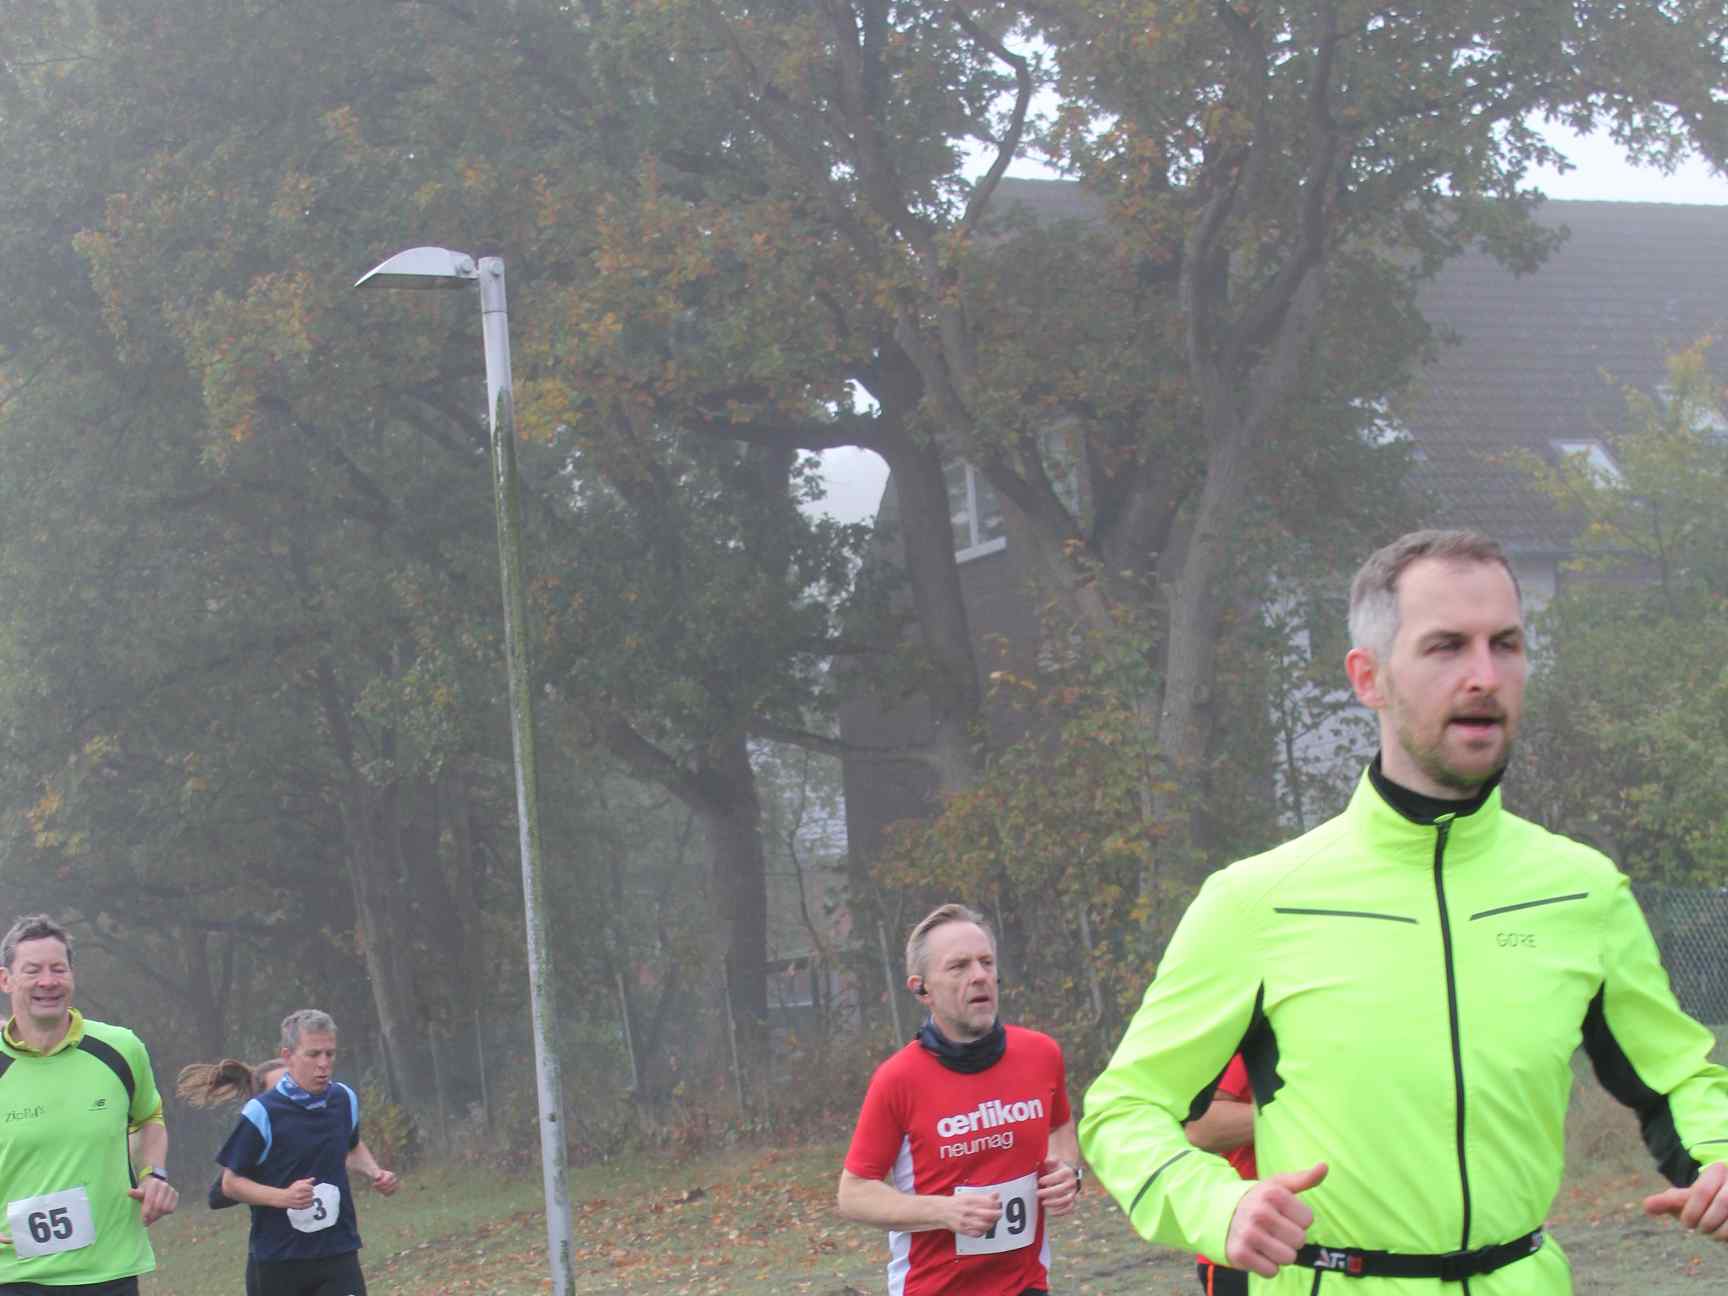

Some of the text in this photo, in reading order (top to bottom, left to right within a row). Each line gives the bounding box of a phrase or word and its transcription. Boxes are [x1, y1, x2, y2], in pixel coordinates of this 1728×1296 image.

[940, 1131, 1014, 1160] neumag
[312, 1197, 328, 1221] 3
[28, 1206, 74, 1244] 65
